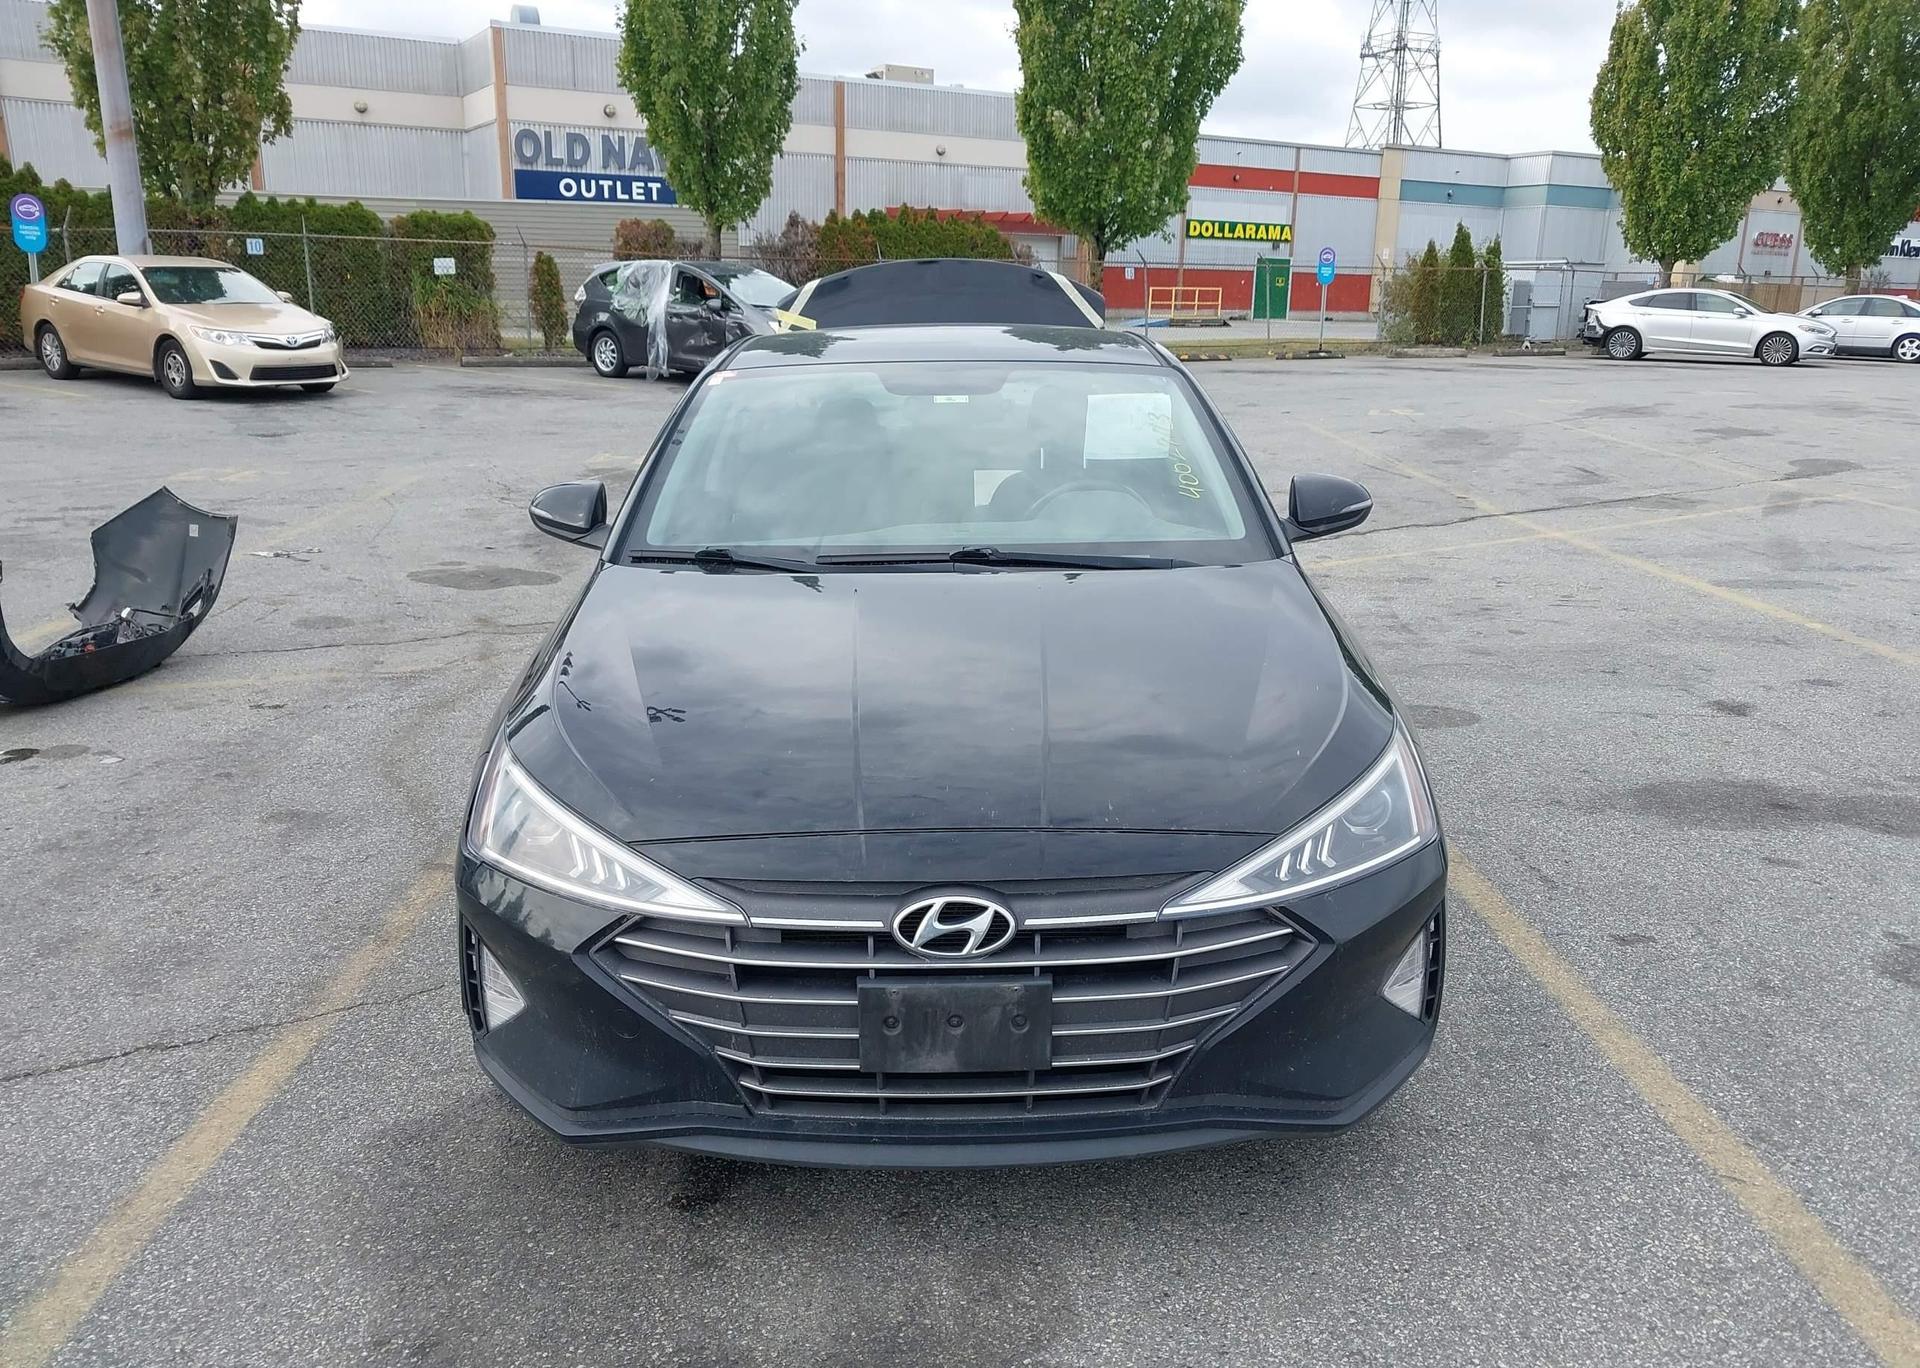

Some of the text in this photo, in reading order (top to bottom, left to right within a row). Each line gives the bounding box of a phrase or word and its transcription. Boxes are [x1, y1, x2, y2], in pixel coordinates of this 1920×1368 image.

[514, 128, 591, 169] OLD
[559, 177, 661, 200] OUTLET
[1189, 220, 1292, 241] DOLLARAMA
[250, 240, 261, 252] 10
